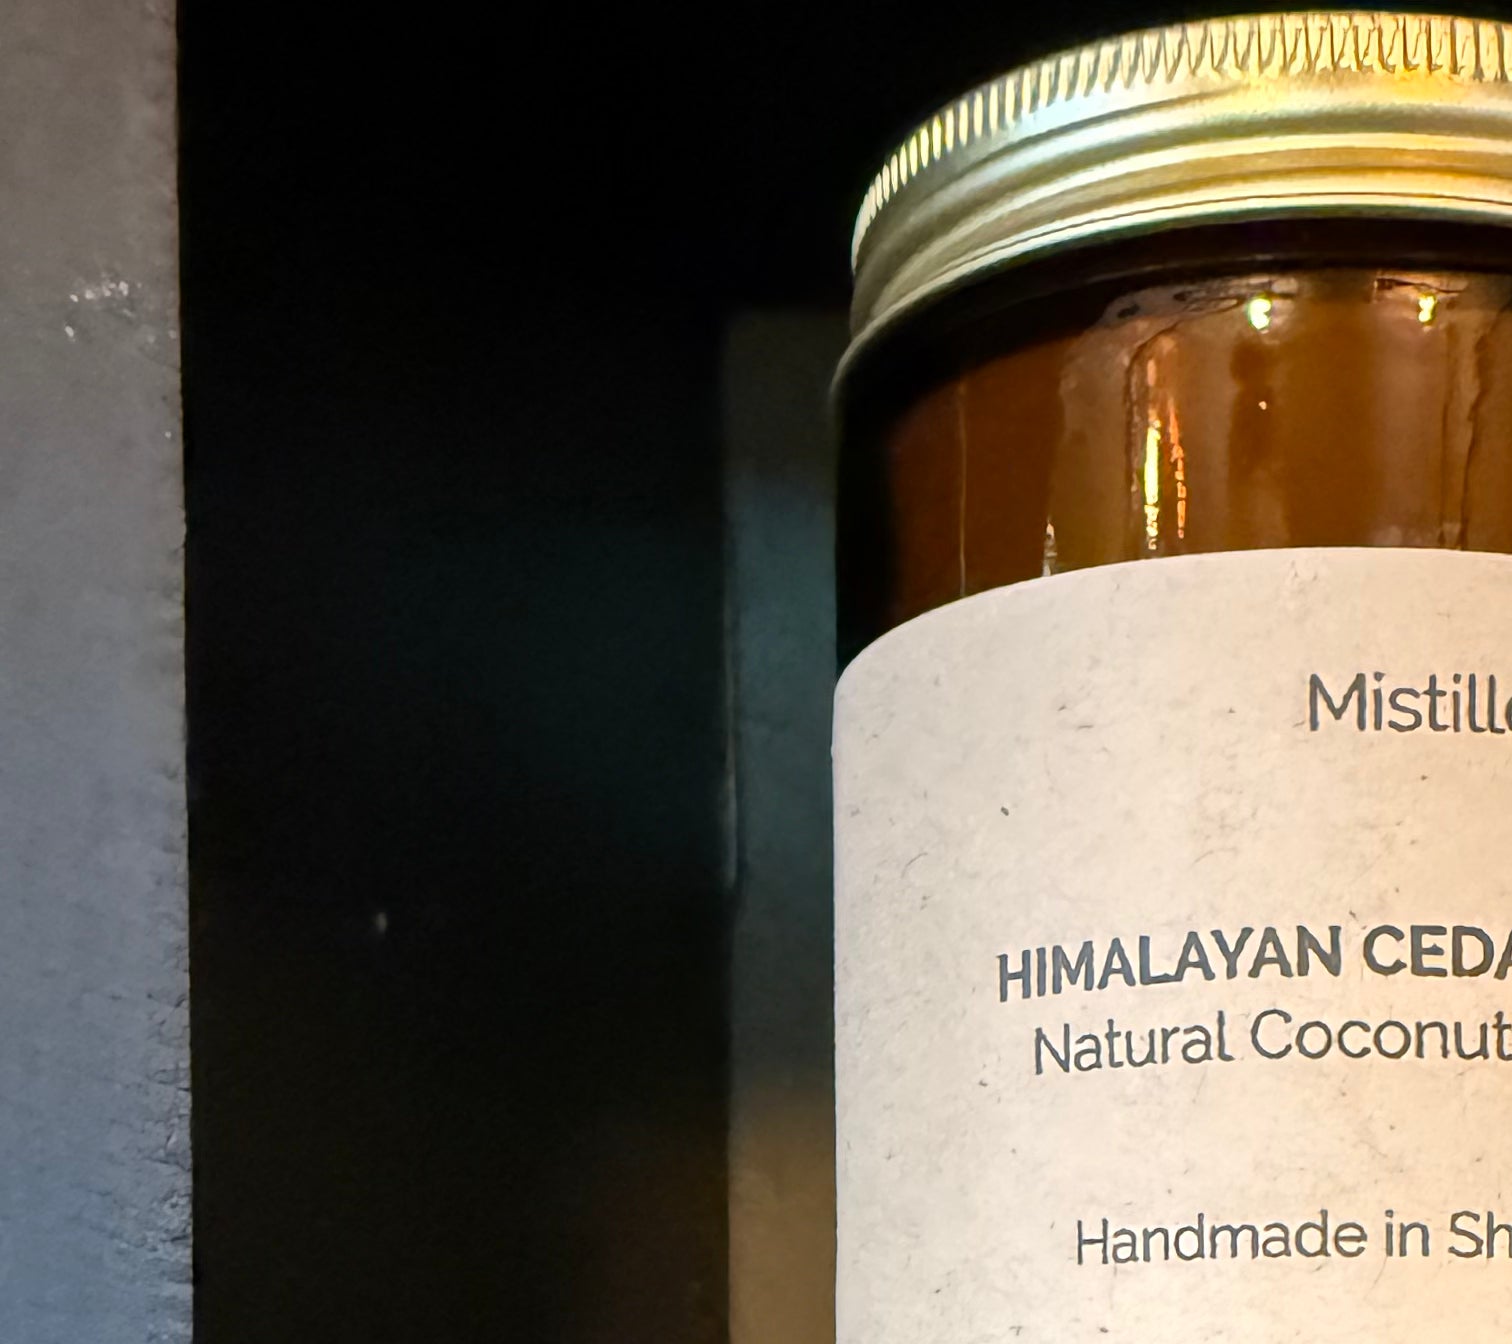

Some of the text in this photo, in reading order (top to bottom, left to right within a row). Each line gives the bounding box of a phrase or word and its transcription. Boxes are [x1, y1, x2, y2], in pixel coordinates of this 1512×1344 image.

[997, 925, 1342, 1002] HIMALAYAN
[1035, 1011, 1235, 1075] Natural
[1077, 1209, 1367, 1265] Handmade
[1385, 1209, 1430, 1258] in
